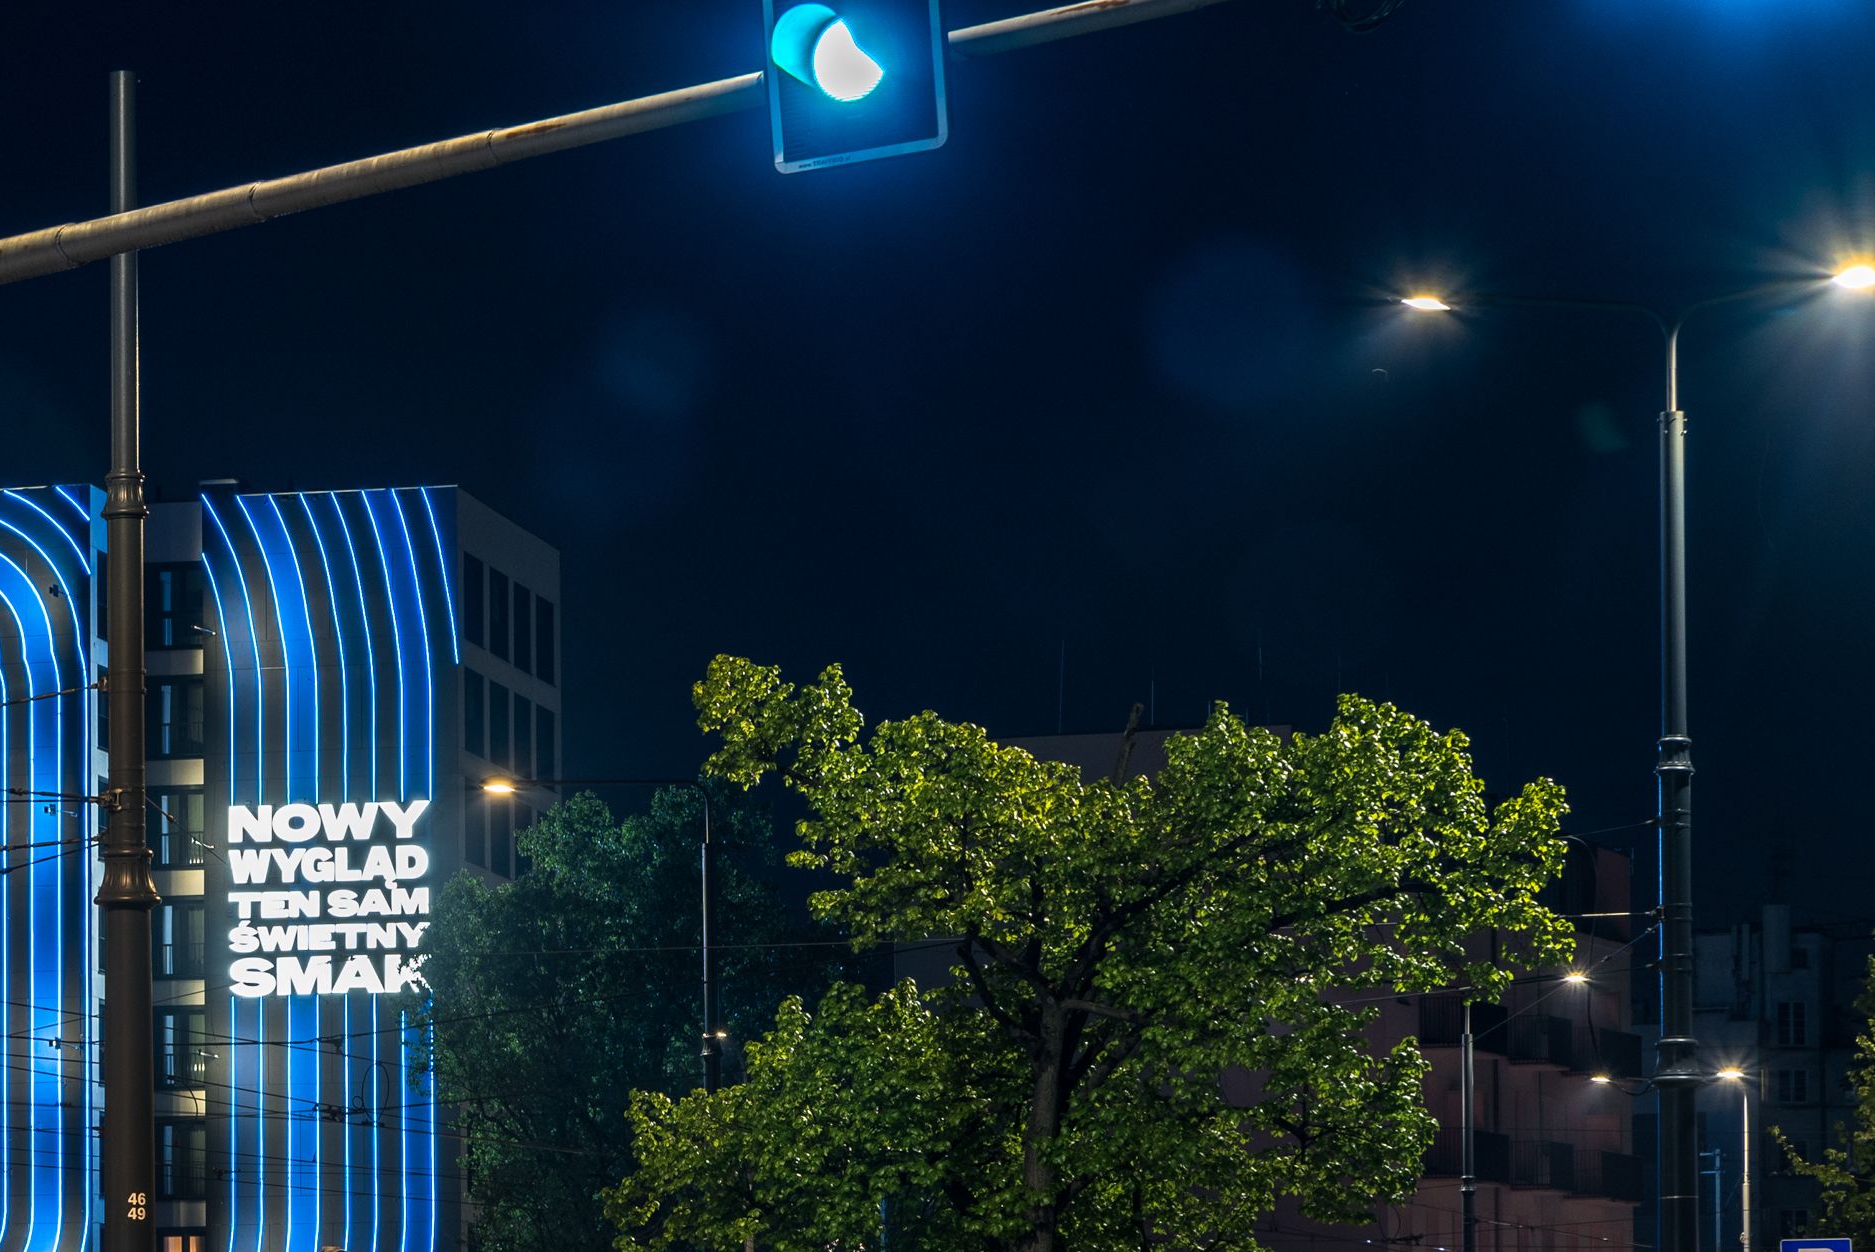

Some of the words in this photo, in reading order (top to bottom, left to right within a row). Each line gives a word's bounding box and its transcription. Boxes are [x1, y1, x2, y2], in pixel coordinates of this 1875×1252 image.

[228, 800, 430, 843] NOWY
[228, 845, 429, 889] WYGLĄD
[228, 890, 320, 919] TEN
[327, 887, 430, 917] SAM
[228, 920, 430, 953] ŚWIETNY
[229, 954, 432, 997] SMAK
[127, 1192, 146, 1206] 46
[127, 1207, 146, 1220] 49
